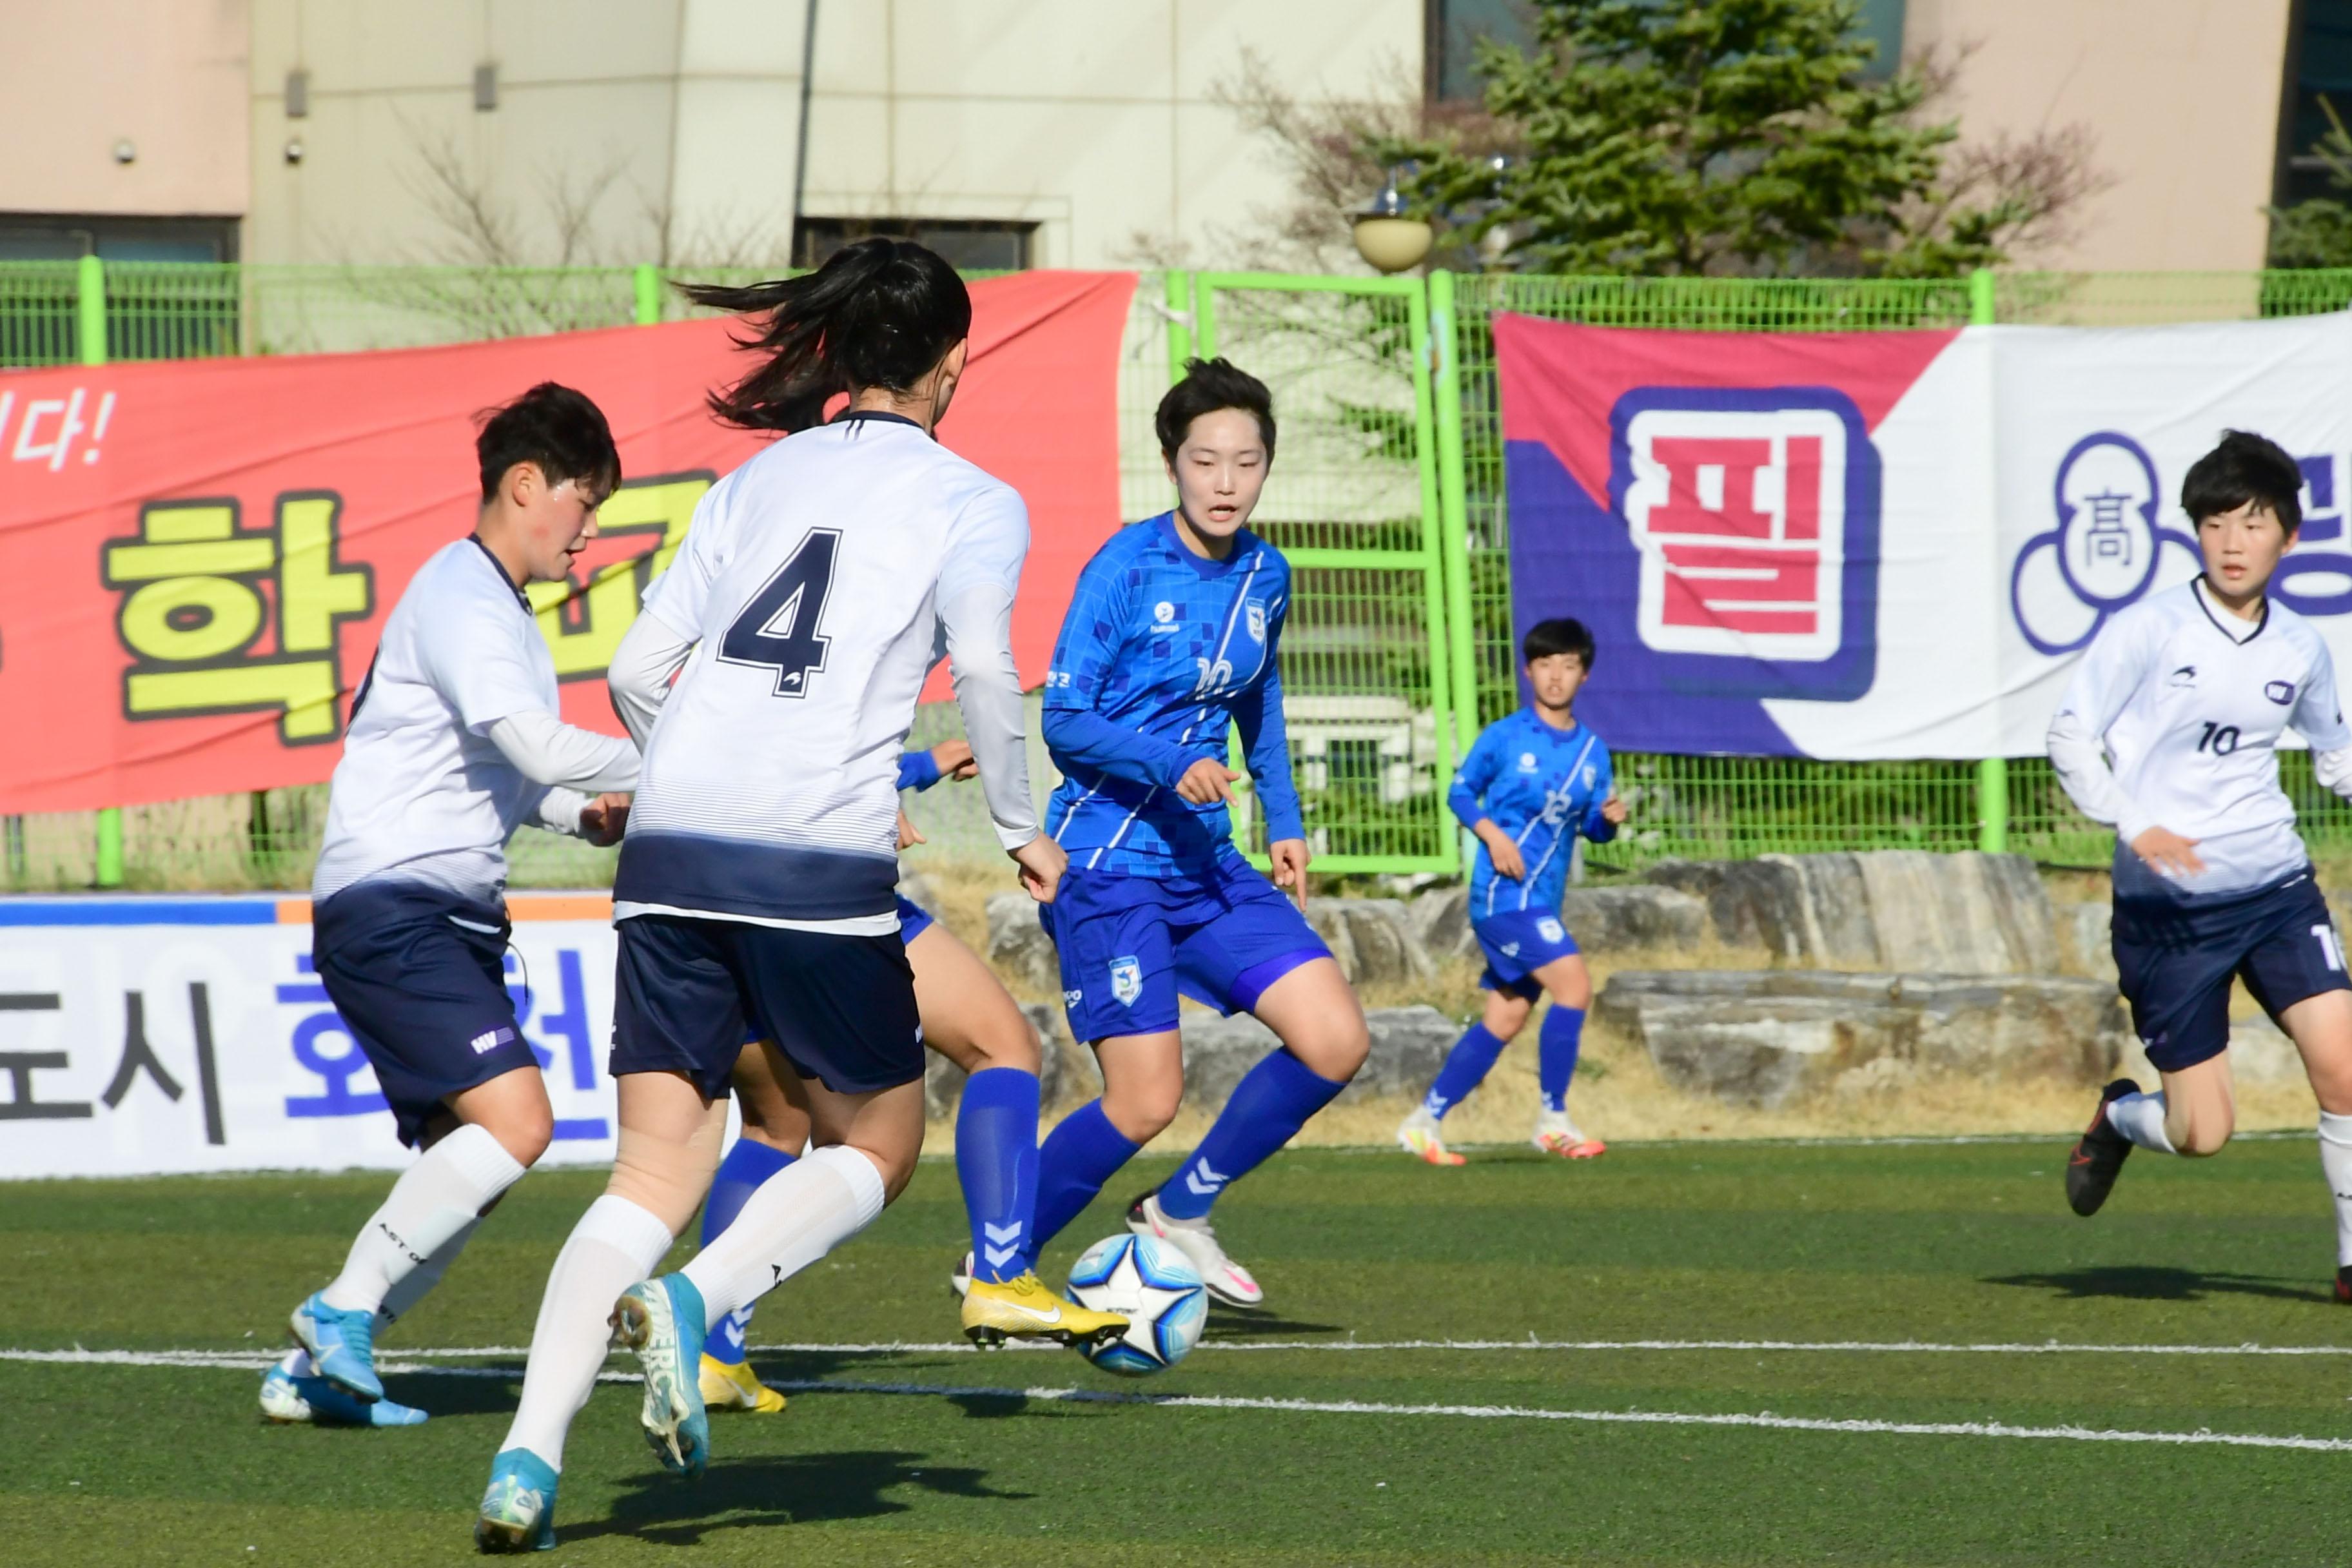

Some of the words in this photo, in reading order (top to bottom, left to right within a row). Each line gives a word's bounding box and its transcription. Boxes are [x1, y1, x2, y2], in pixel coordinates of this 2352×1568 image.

[2084, 486, 2133, 567] 高
[716, 526, 843, 699] 4
[1195, 657, 1233, 701] 10
[2197, 721, 2240, 756] 10
